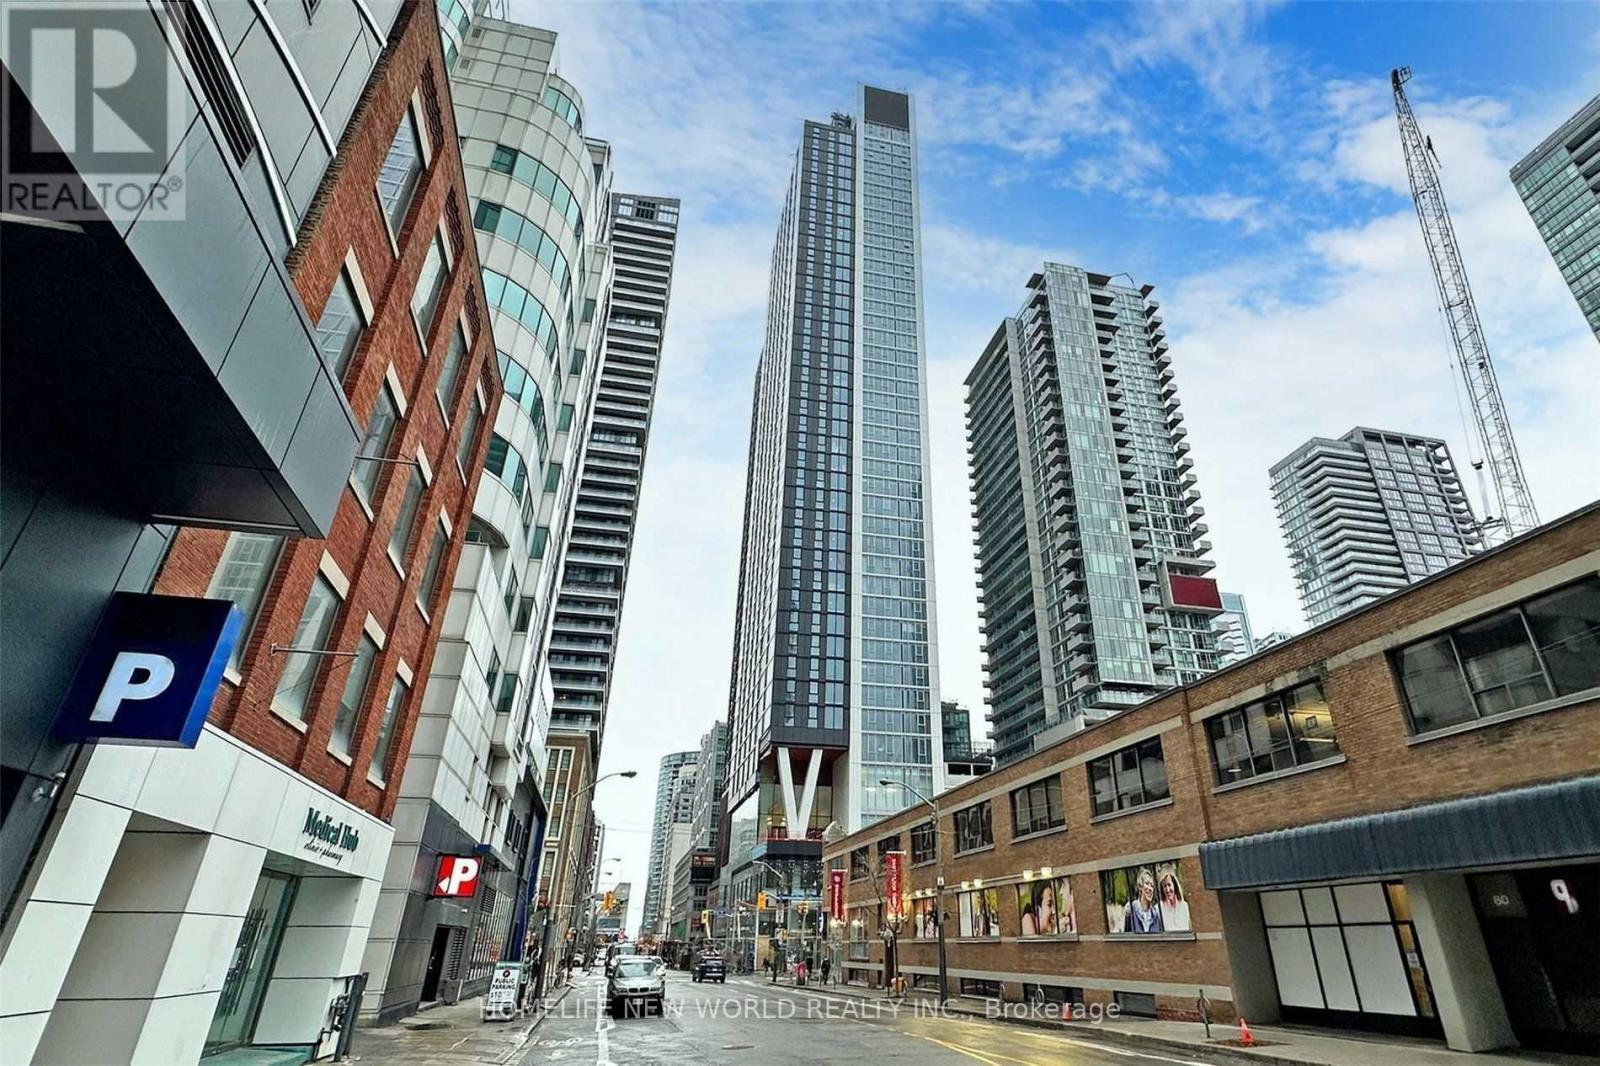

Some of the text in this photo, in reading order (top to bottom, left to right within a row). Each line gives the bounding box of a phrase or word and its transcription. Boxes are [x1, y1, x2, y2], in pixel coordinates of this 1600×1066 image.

[88, 651, 176, 722] P
[302, 807, 359, 853] Medical Hub
[447, 858, 479, 895] P
